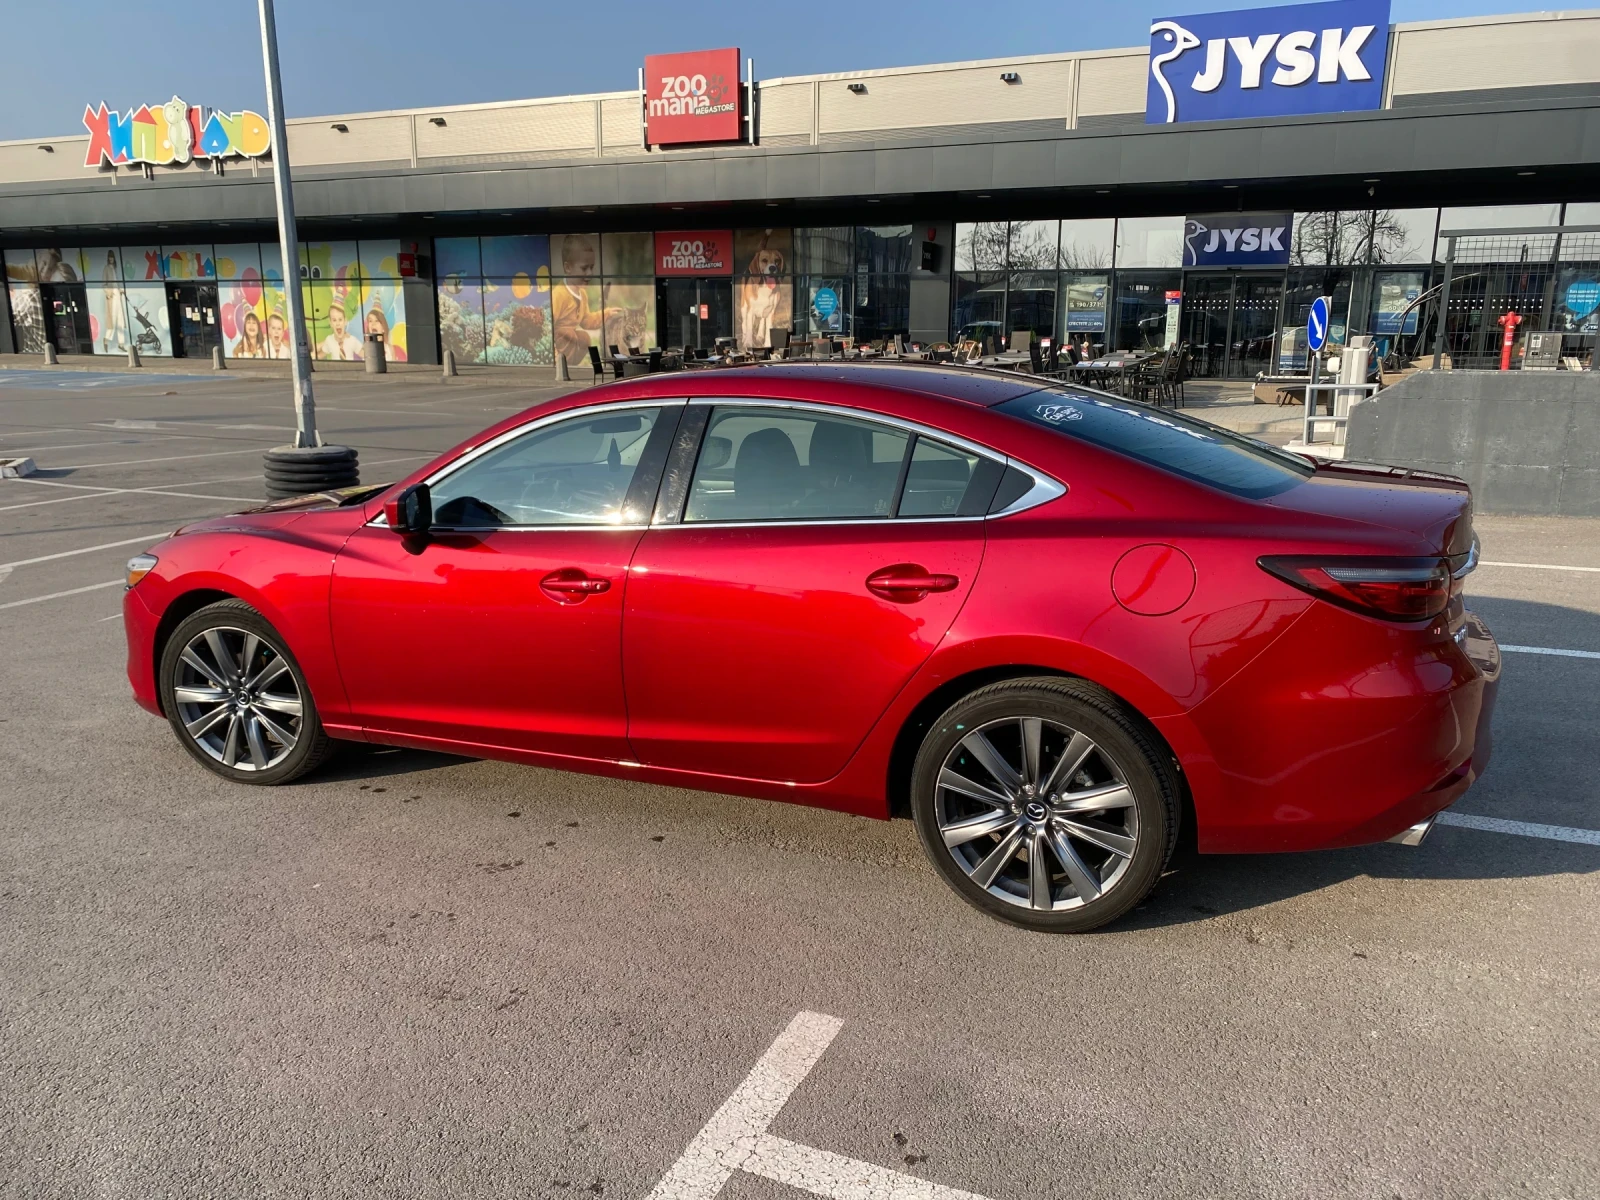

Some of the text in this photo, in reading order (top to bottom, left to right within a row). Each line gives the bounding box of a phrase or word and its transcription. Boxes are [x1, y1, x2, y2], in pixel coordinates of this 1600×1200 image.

[1191, 25, 1376, 92] JYSK
[649, 95, 711, 117] mania
[695, 102, 735, 115] MEGASTORE
[1203, 227, 1286, 253] JYSK
